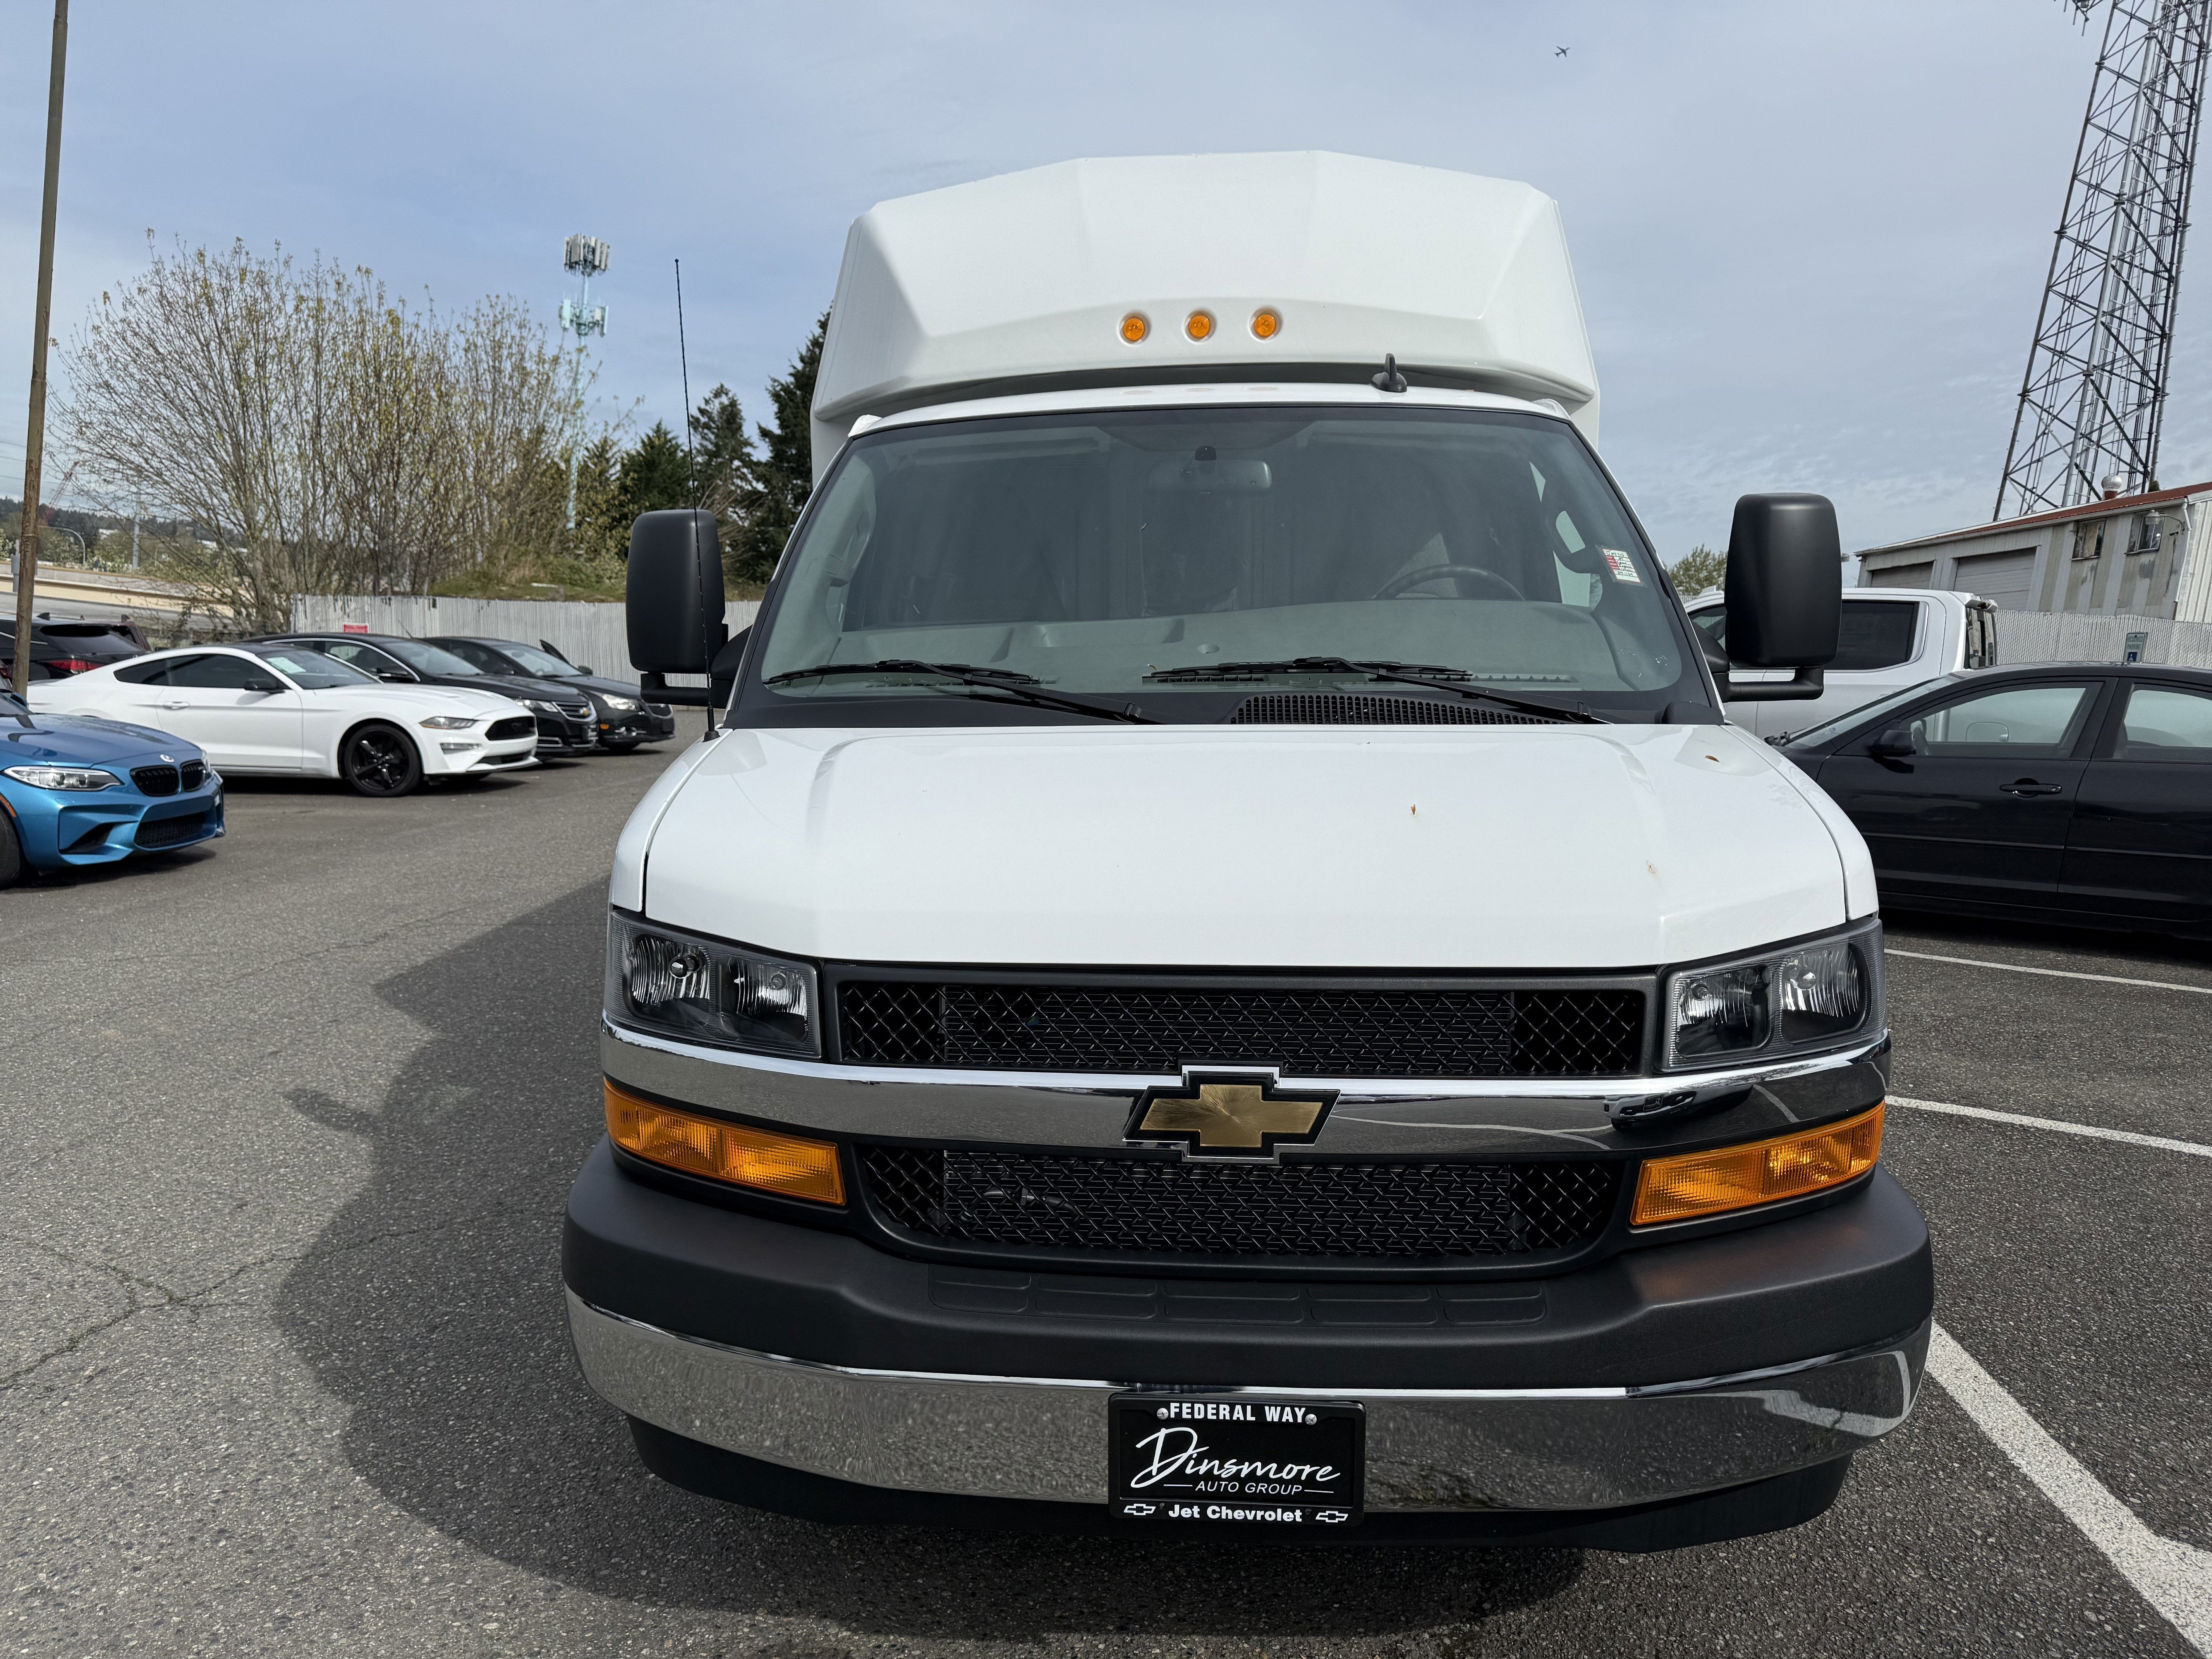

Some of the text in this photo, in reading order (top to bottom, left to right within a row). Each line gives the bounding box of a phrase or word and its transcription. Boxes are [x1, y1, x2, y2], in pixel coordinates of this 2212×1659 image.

[1170, 1402, 1306, 1423] FEDERAL WAY
[1131, 1427, 1341, 1488] Dinsmore
[1195, 1481, 1302, 1495] AUTO GROUP
[1168, 1504, 1302, 1522] Jet Chevrolet
